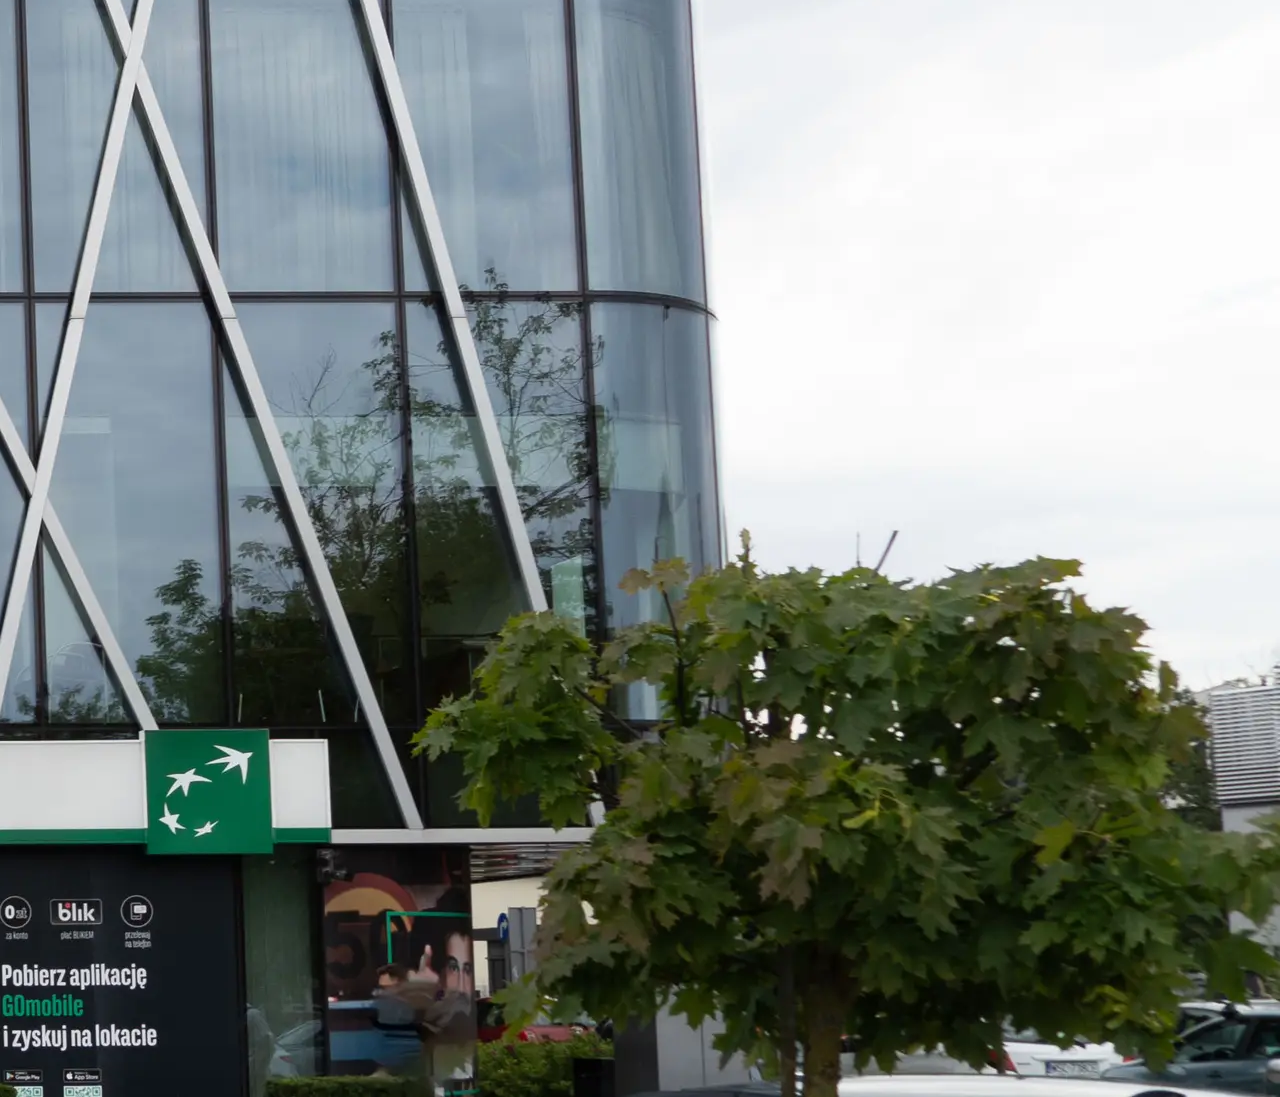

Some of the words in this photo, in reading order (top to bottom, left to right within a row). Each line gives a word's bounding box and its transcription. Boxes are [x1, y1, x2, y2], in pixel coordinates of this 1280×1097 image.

[4, 904, 16, 920] 0
[58, 902, 96, 922] blik
[1, 964, 66, 986] Pobierz
[69, 963, 147, 990] aplikację
[2, 994, 84, 1017] GOmobile
[3, 1025, 9, 1047] i
[12, 1024, 67, 1051] zyskuj
[71, 1029, 92, 1047] na
[95, 1024, 157, 1047] lokacie
